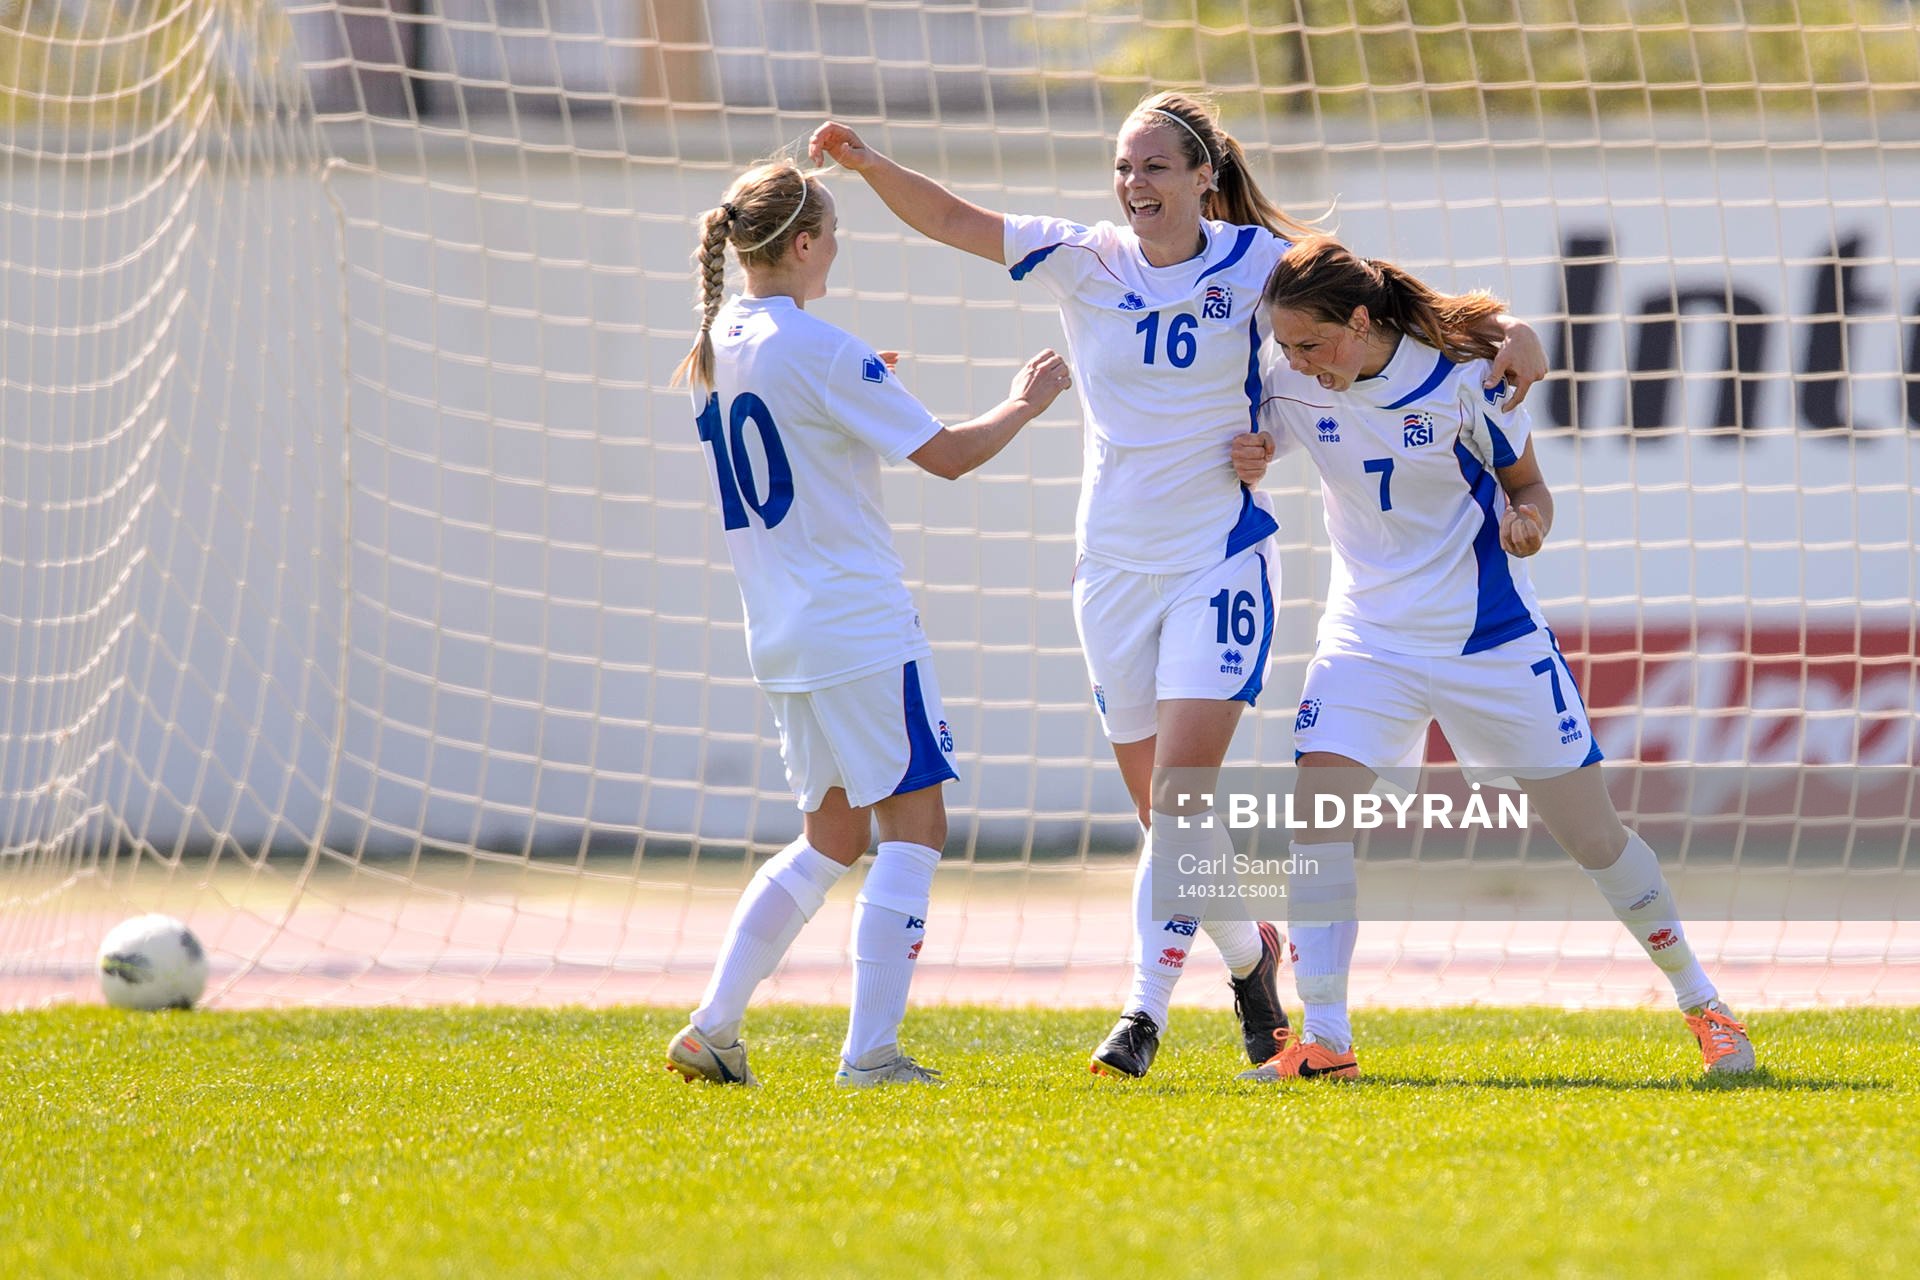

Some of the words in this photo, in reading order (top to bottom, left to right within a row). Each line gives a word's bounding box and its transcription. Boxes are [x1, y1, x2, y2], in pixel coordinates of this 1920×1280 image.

[1136, 311, 1199, 369] 16
[696, 391, 794, 531] 10
[1363, 457, 1395, 512] 7
[1209, 588, 1256, 646] 16
[1530, 656, 1567, 714] 7
